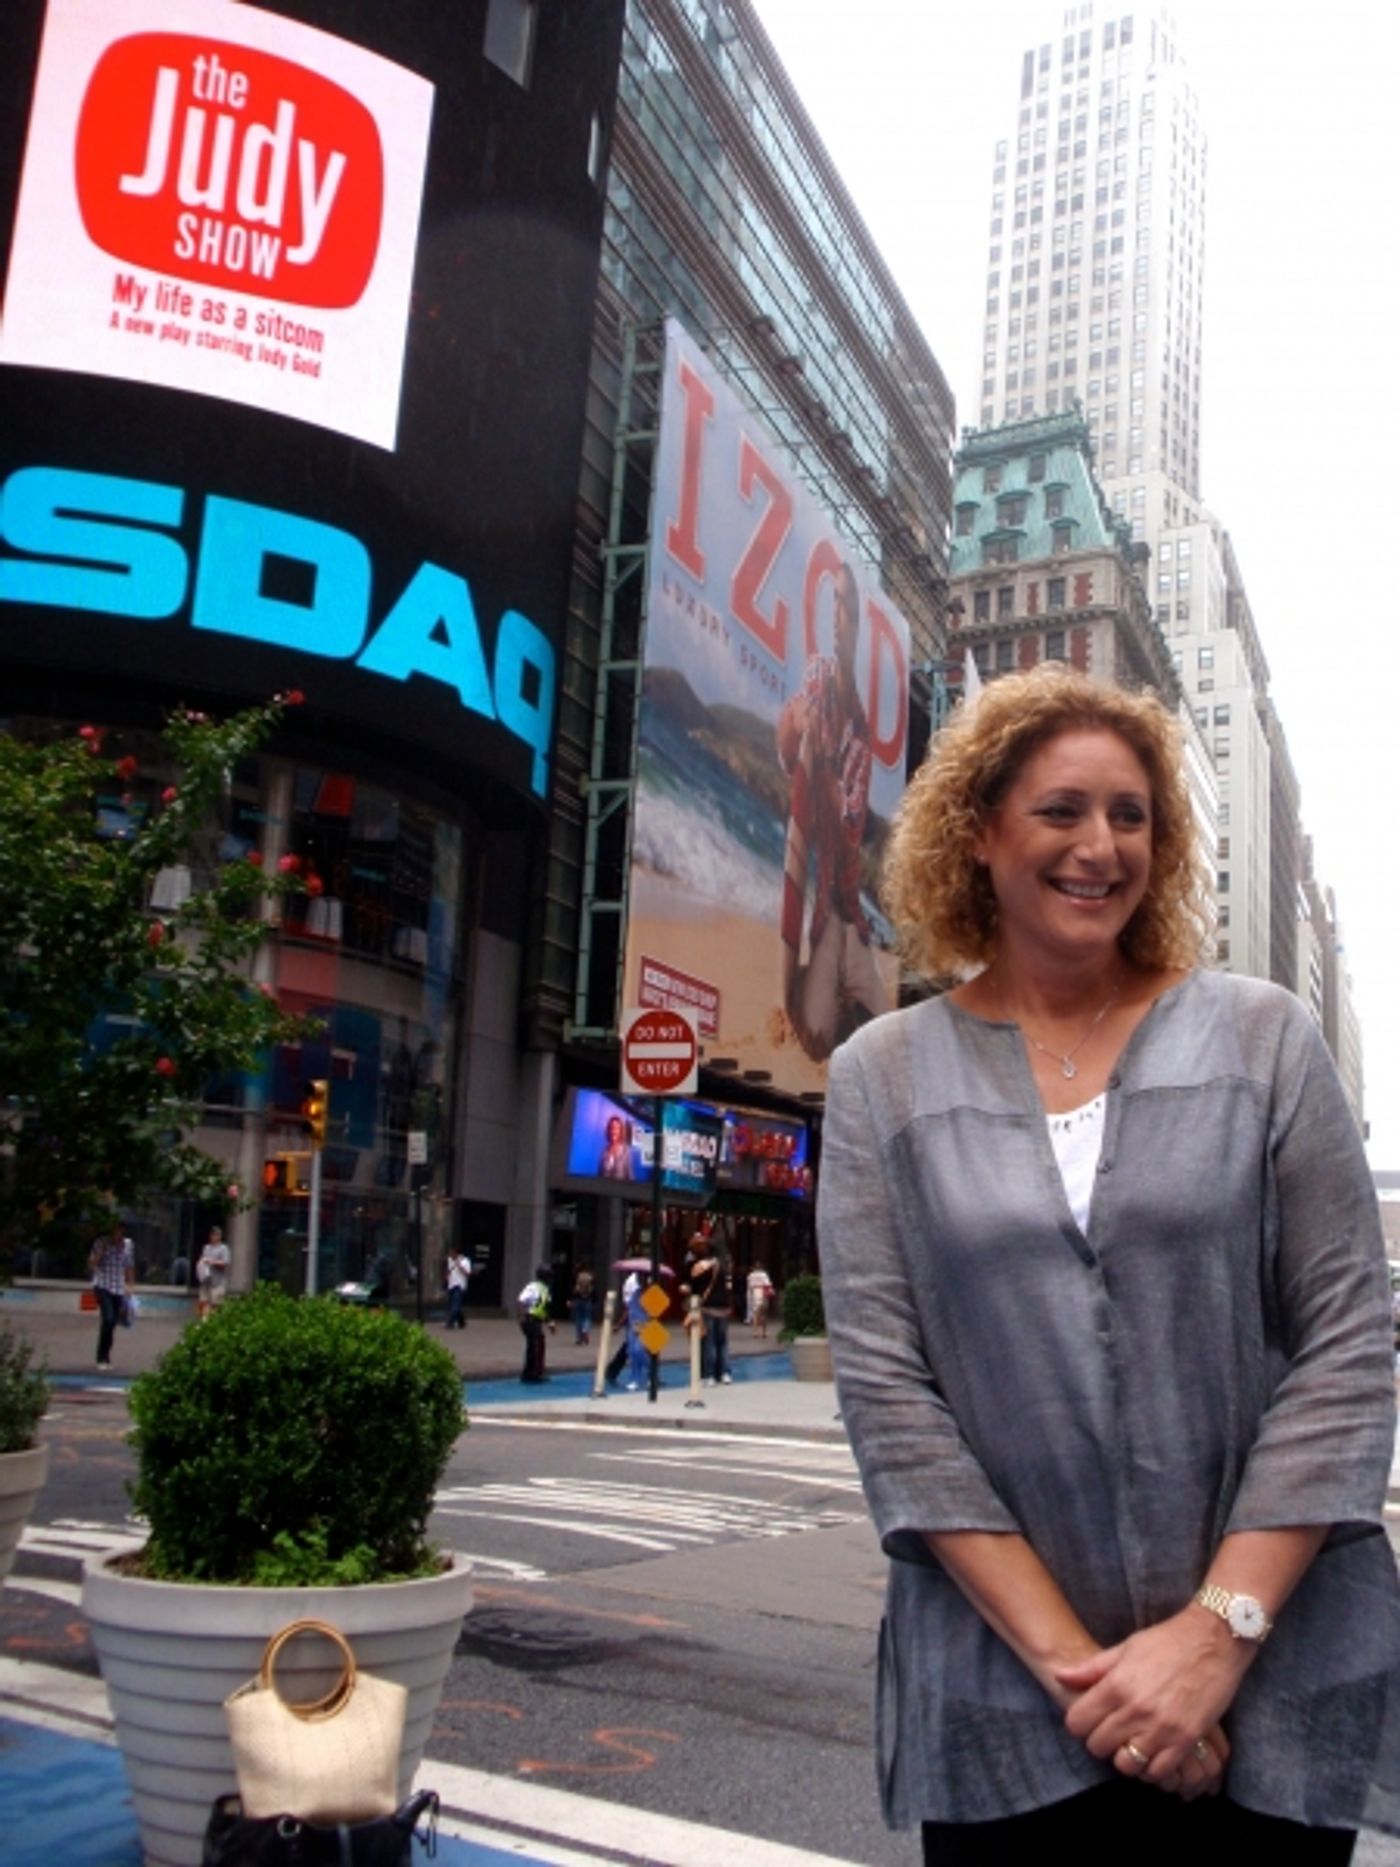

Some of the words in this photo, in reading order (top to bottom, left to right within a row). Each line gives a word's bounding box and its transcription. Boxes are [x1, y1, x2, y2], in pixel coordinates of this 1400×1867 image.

[192, 54, 249, 109] the
[118, 66, 347, 266] Judy
[173, 212, 281, 280] SHOW
[110, 311, 120, 329] A
[125, 316, 155, 335] new
[159, 321, 191, 347] play
[196, 330, 254, 362] starring
[292, 352, 322, 379] Gold
[112, 273, 148, 313] My
[156, 280, 194, 317] life
[200, 298, 227, 325] as
[234, 307, 248, 331] a
[255, 308, 326, 353] sitcom
[0, 466, 557, 800] SDAQ
[662, 572, 731, 646] LUXURY
[740, 643, 786, 703] SPORT
[635, 1026, 654, 1040] DO
[658, 1025, 684, 1040] NOT
[637, 1062, 680, 1077] ENTER
